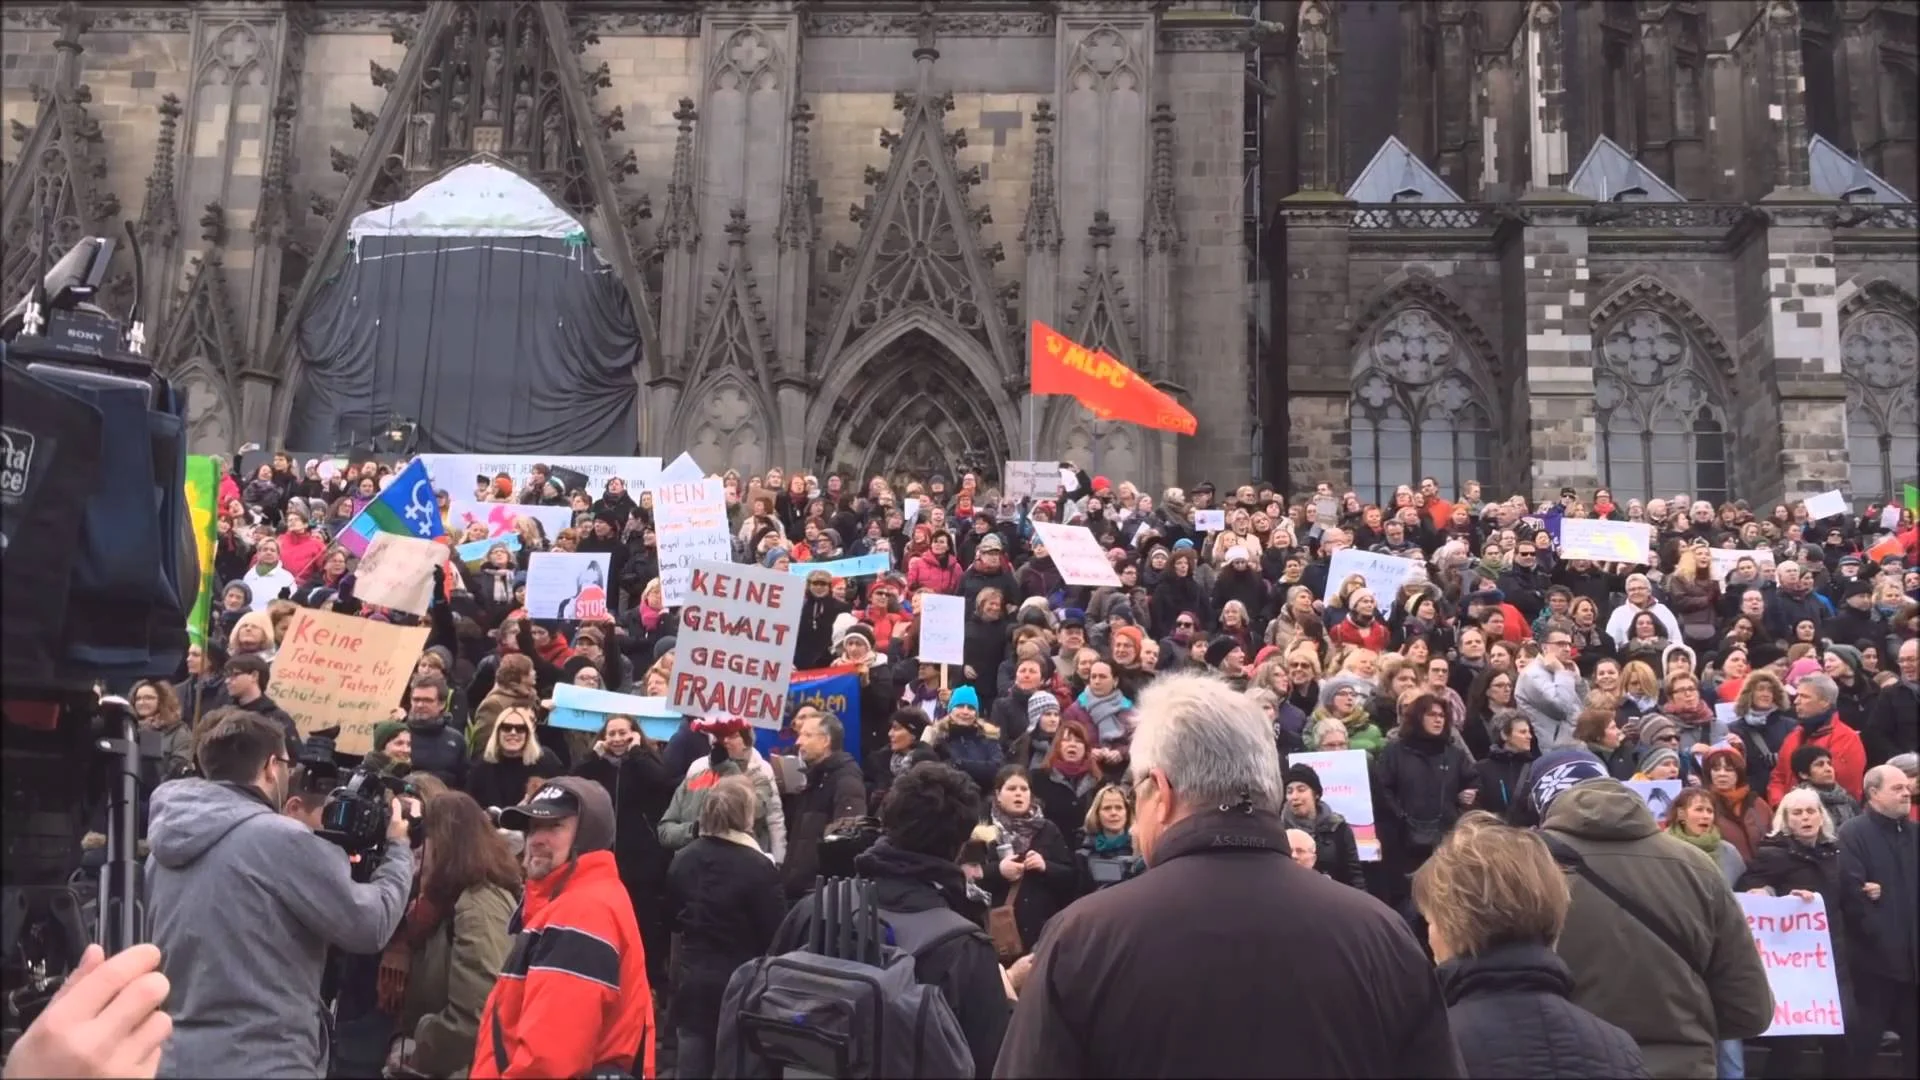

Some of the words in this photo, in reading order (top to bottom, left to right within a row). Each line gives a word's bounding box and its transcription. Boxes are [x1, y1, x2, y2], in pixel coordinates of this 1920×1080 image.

[659, 483, 705, 504] NEIN
[691, 568, 785, 610] KEINE
[291, 614, 363, 653] Keine
[682, 604, 790, 646] GEWALT
[290, 646, 364, 675] Toleranz
[371, 659, 396, 678] für
[690, 646, 782, 683] GEGEN
[672, 671, 785, 722] FRAUEN
[1779, 911, 1827, 933] uns
[1756, 938, 1828, 969] hwert
[1774, 999, 1841, 1027] Nacht
